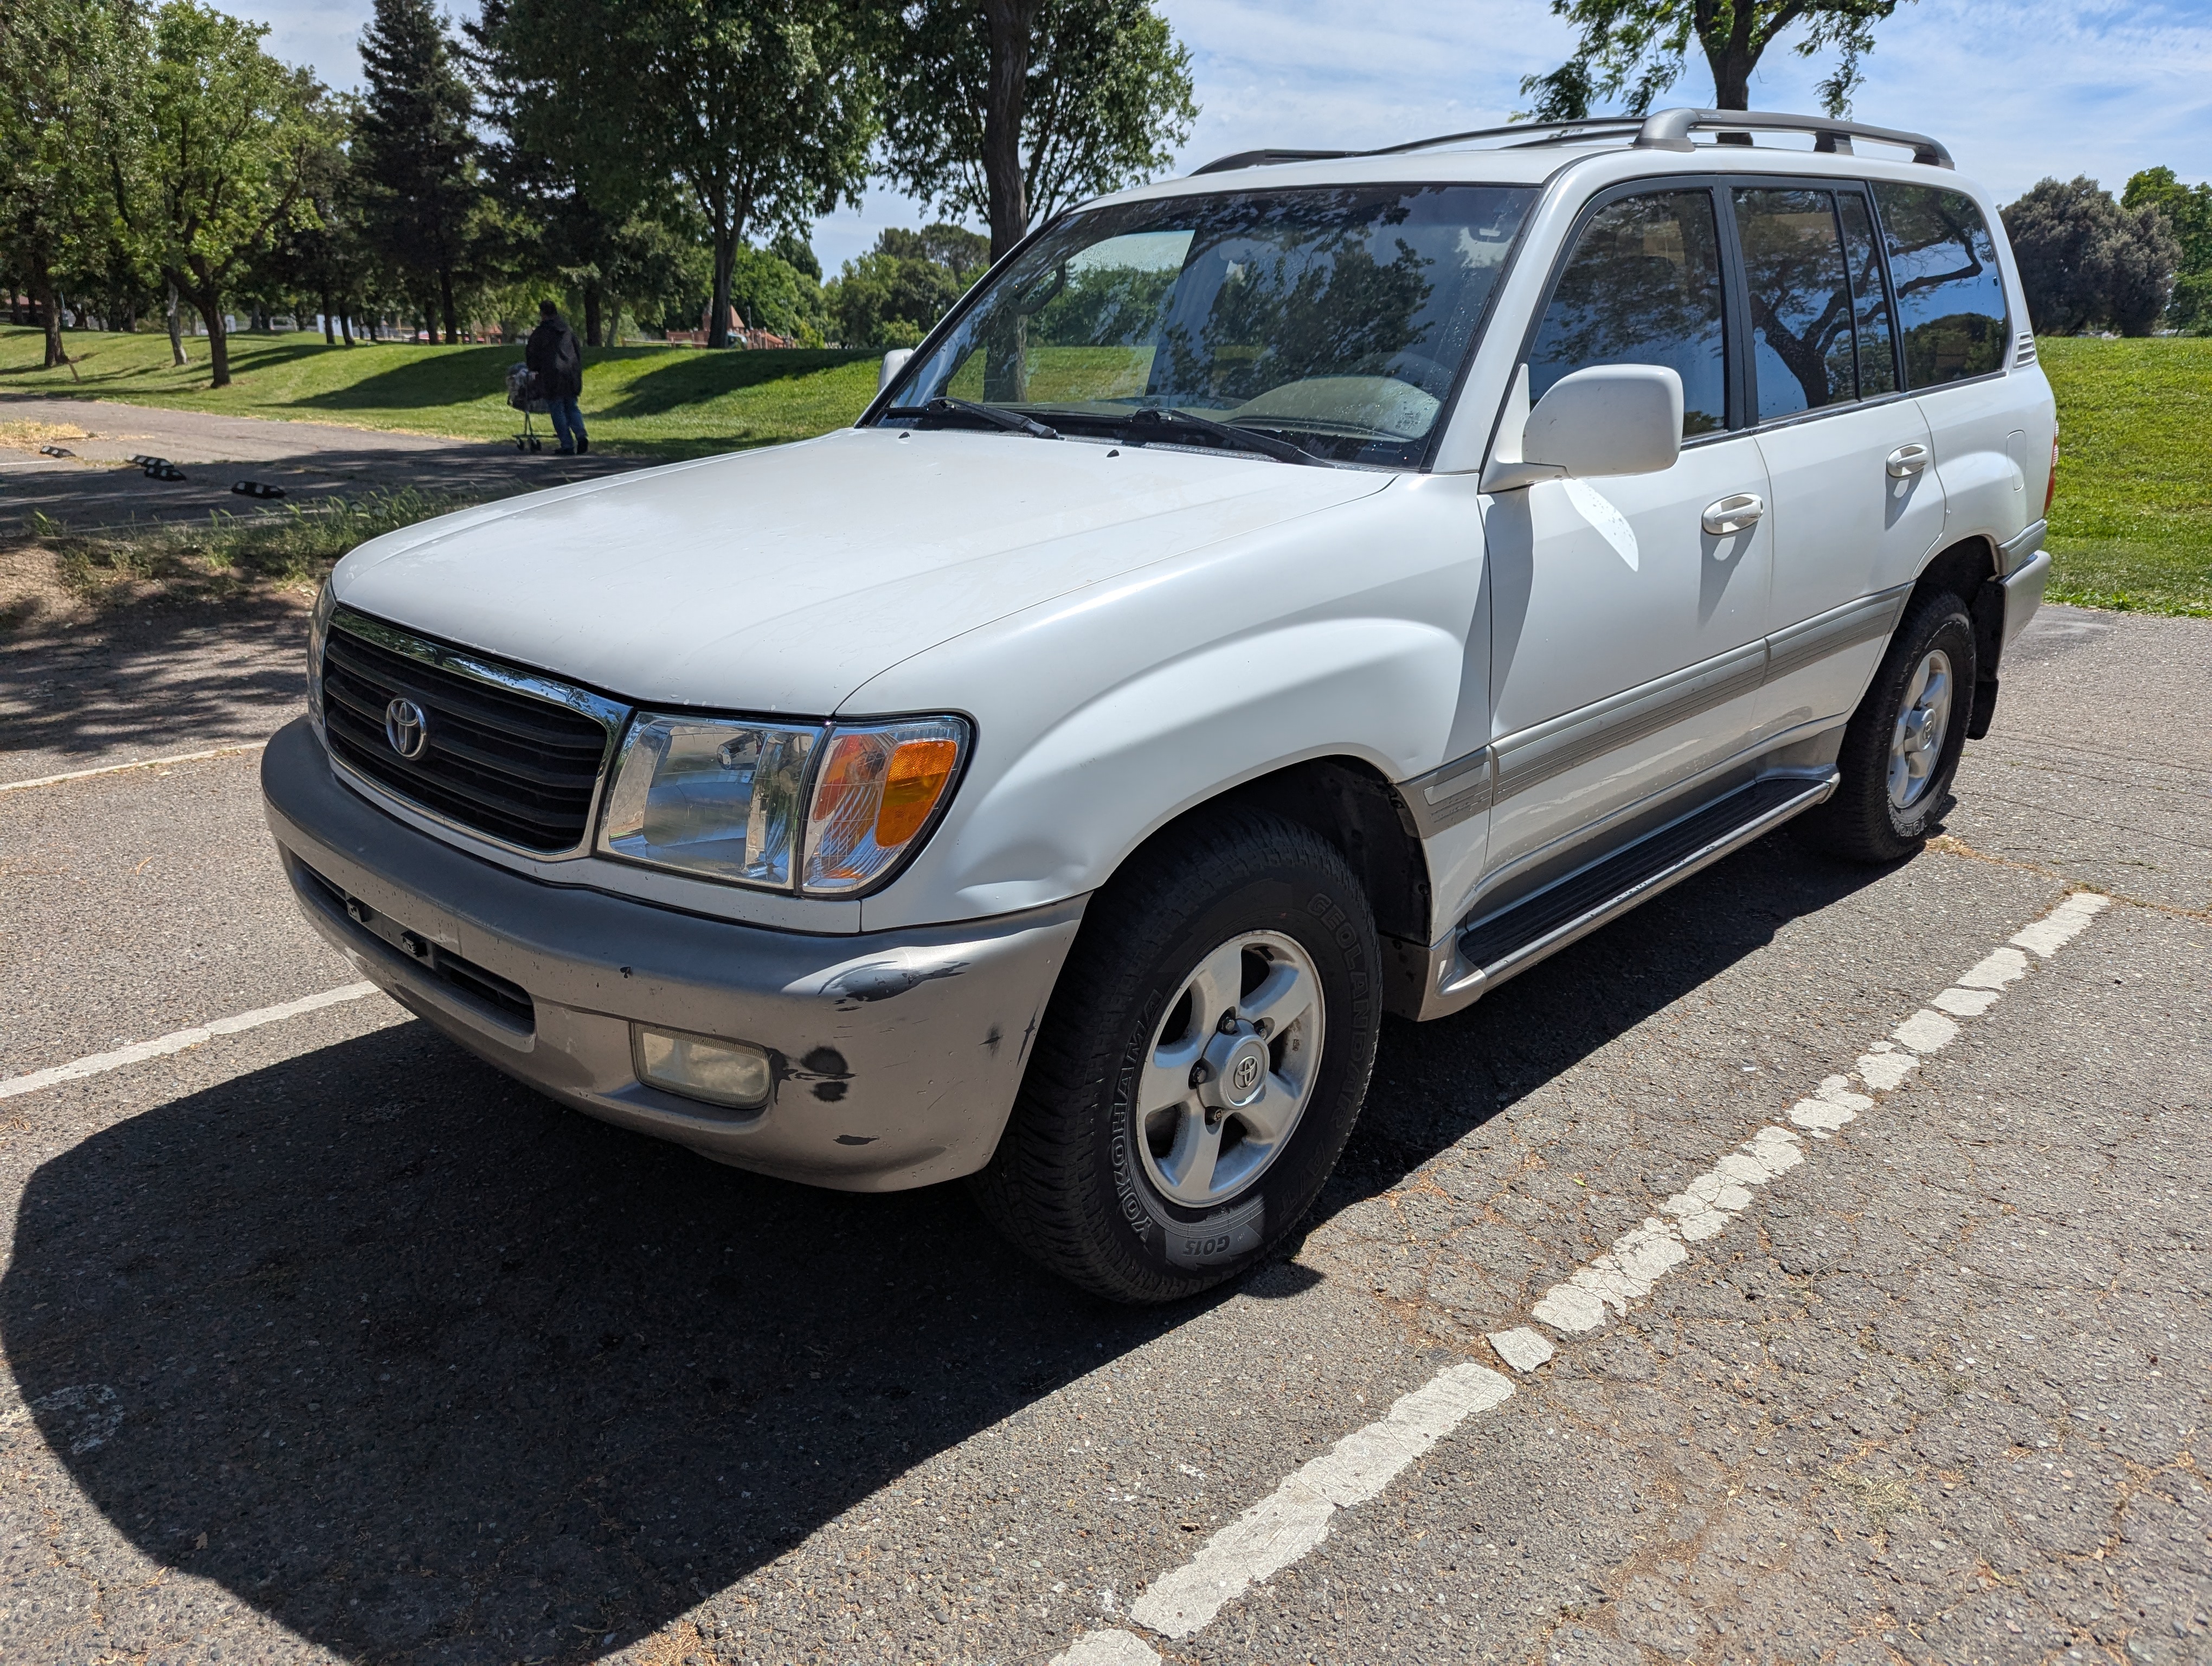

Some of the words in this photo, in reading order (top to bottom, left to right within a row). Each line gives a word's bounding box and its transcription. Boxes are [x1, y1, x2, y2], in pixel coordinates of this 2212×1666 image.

[1111, 989, 1163, 1243] YOKOHAMA
[1307, 892, 1370, 1129] GEOLANDAR
[1279, 1139, 1326, 1222] A/T
